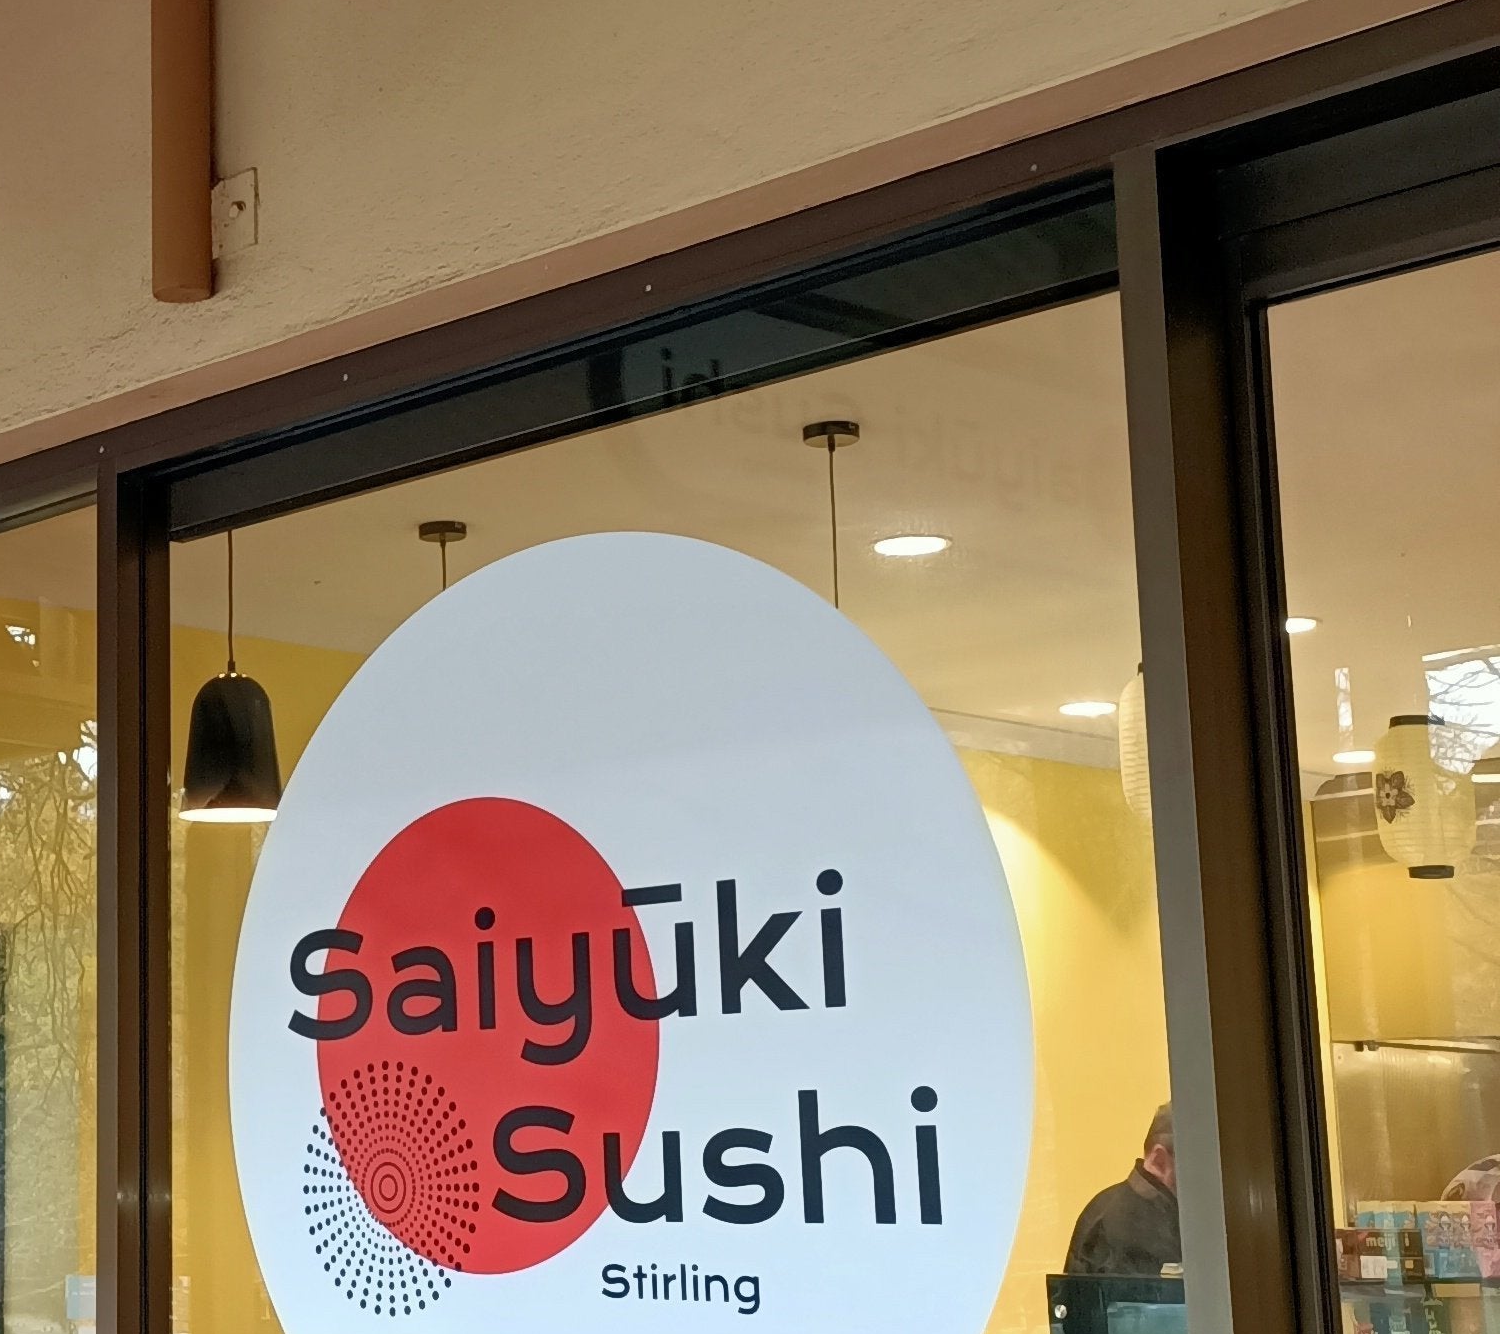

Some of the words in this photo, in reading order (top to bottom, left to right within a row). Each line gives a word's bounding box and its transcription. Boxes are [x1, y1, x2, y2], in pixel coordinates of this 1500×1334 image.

[287, 868, 847, 1066] Saiyūki
[490, 1085, 943, 1225] Sushi
[600, 1262, 762, 1315] Stirling
